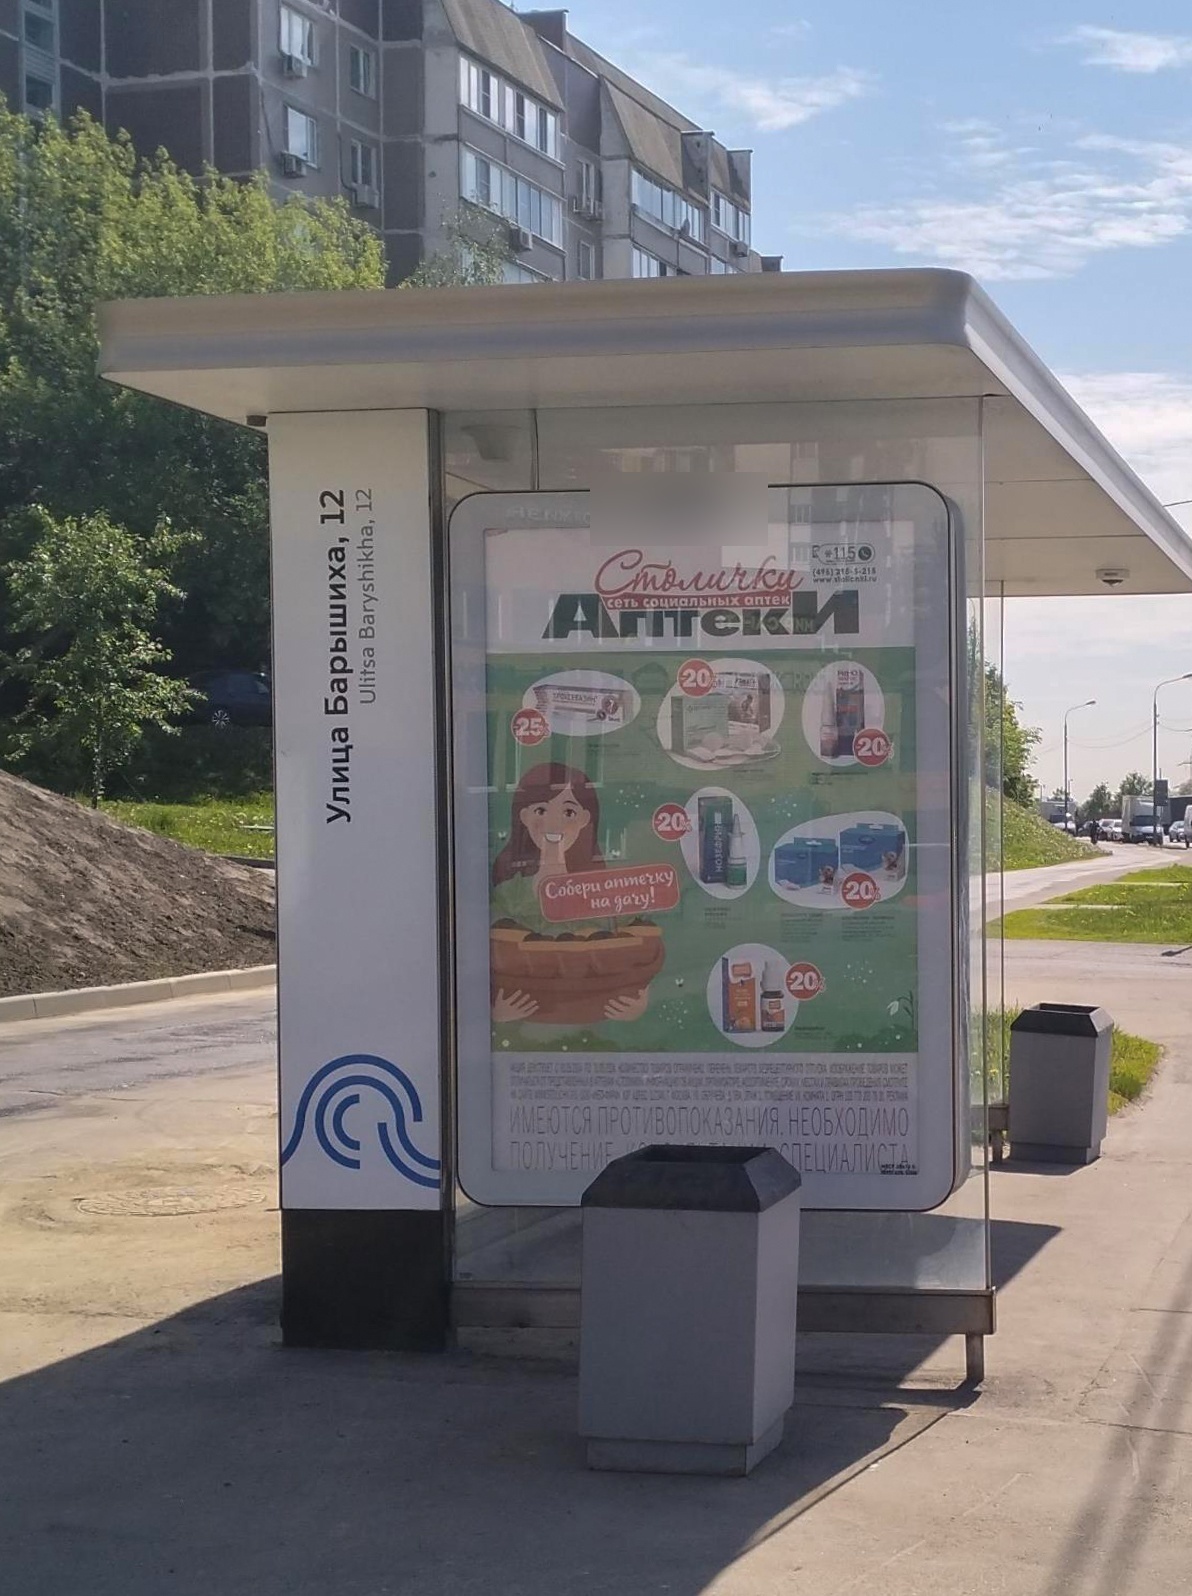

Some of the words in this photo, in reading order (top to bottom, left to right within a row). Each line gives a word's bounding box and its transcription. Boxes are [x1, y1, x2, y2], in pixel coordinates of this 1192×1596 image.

[319, 489, 345, 524] 12
[355, 488, 373, 512] 12
[357, 518, 380, 638] Baryshikha,
[594, 549, 804, 596] Столички
[607, 598, 640, 609] сеть
[643, 595, 740, 610] социальных
[744, 594, 791, 607] аптек
[324, 535, 354, 716] Барышиха,
[358, 647, 376, 704] Ulitsa
[325, 727, 354, 826] Улица
[546, 878, 601, 902] Собери
[605, 870, 675, 890] аптечку
[590, 894, 612, 910] на
[614, 886, 656, 912] дачу!
[509, 1106, 592, 1135] ИМЕЮТСЯ
[598, 1106, 784, 1137] ПРОТИВОПОКАЗАНИЯ.
[789, 1107, 909, 1139] НЕОБХОДИМО
